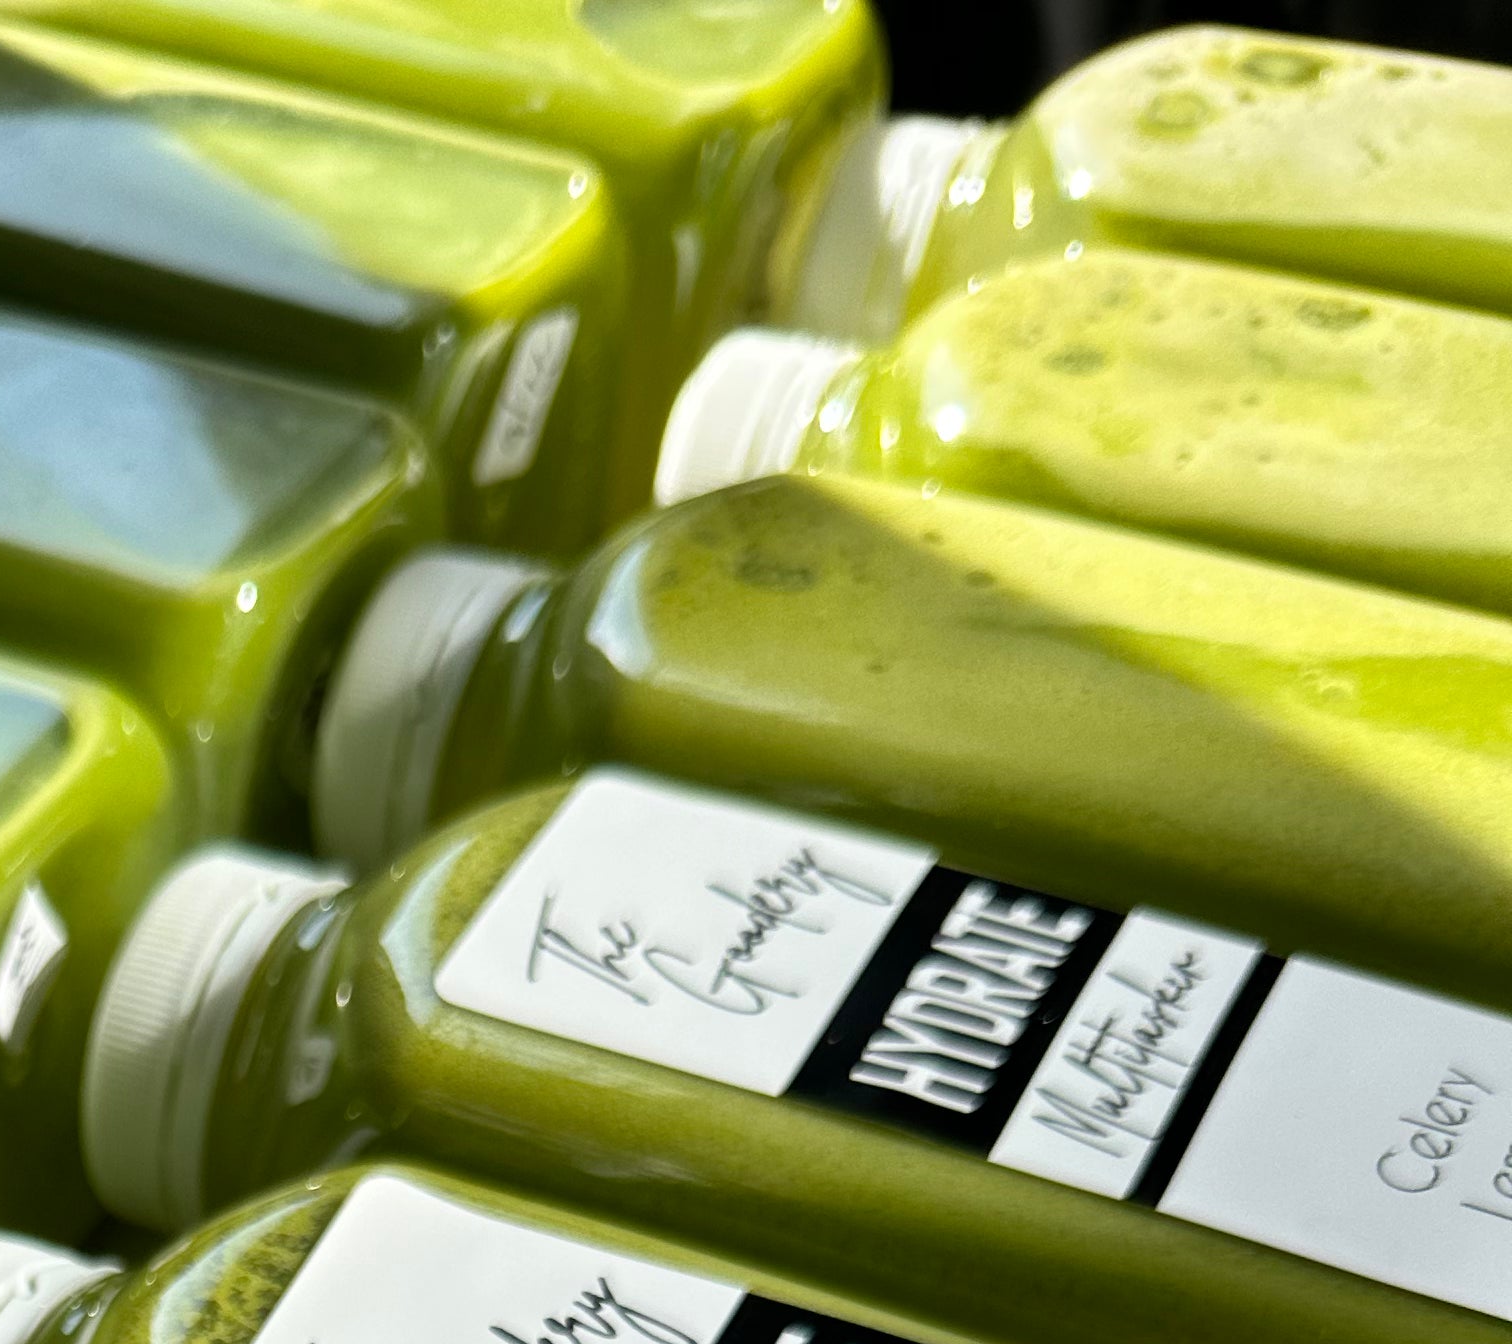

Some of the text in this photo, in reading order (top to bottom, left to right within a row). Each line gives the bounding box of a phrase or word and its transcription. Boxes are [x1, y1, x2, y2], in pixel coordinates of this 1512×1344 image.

[528, 896, 649, 1005] The
[849, 882, 1092, 1114] HYDRATE
[1377, 1069, 1492, 1193] Celery
